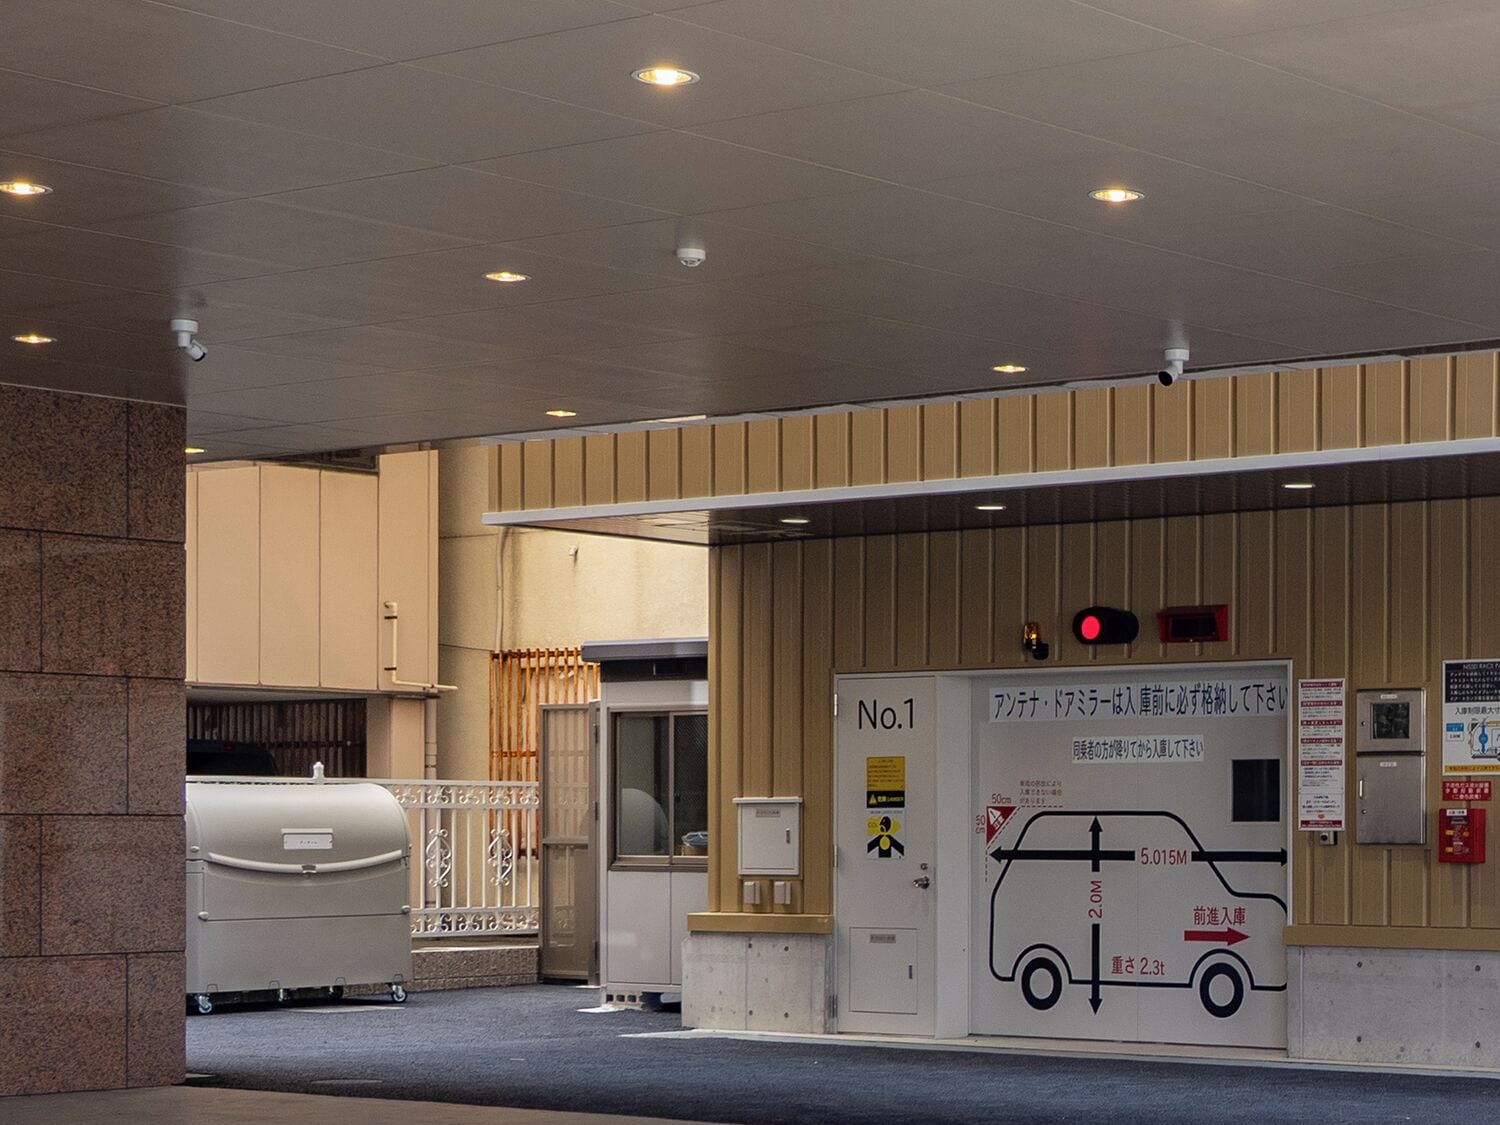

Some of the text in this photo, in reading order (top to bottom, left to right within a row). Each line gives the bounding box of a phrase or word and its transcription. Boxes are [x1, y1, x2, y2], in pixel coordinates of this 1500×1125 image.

[858, 698, 915, 730] No.1
[992, 794, 1012, 804] 50cm
[1140, 847, 1188, 866] 5.015M
[1088, 880, 1103, 918] 2.0M
[1193, 906, 1247, 926] 前進入庫
[1111, 955, 1165, 976] 重さ 2.3t
